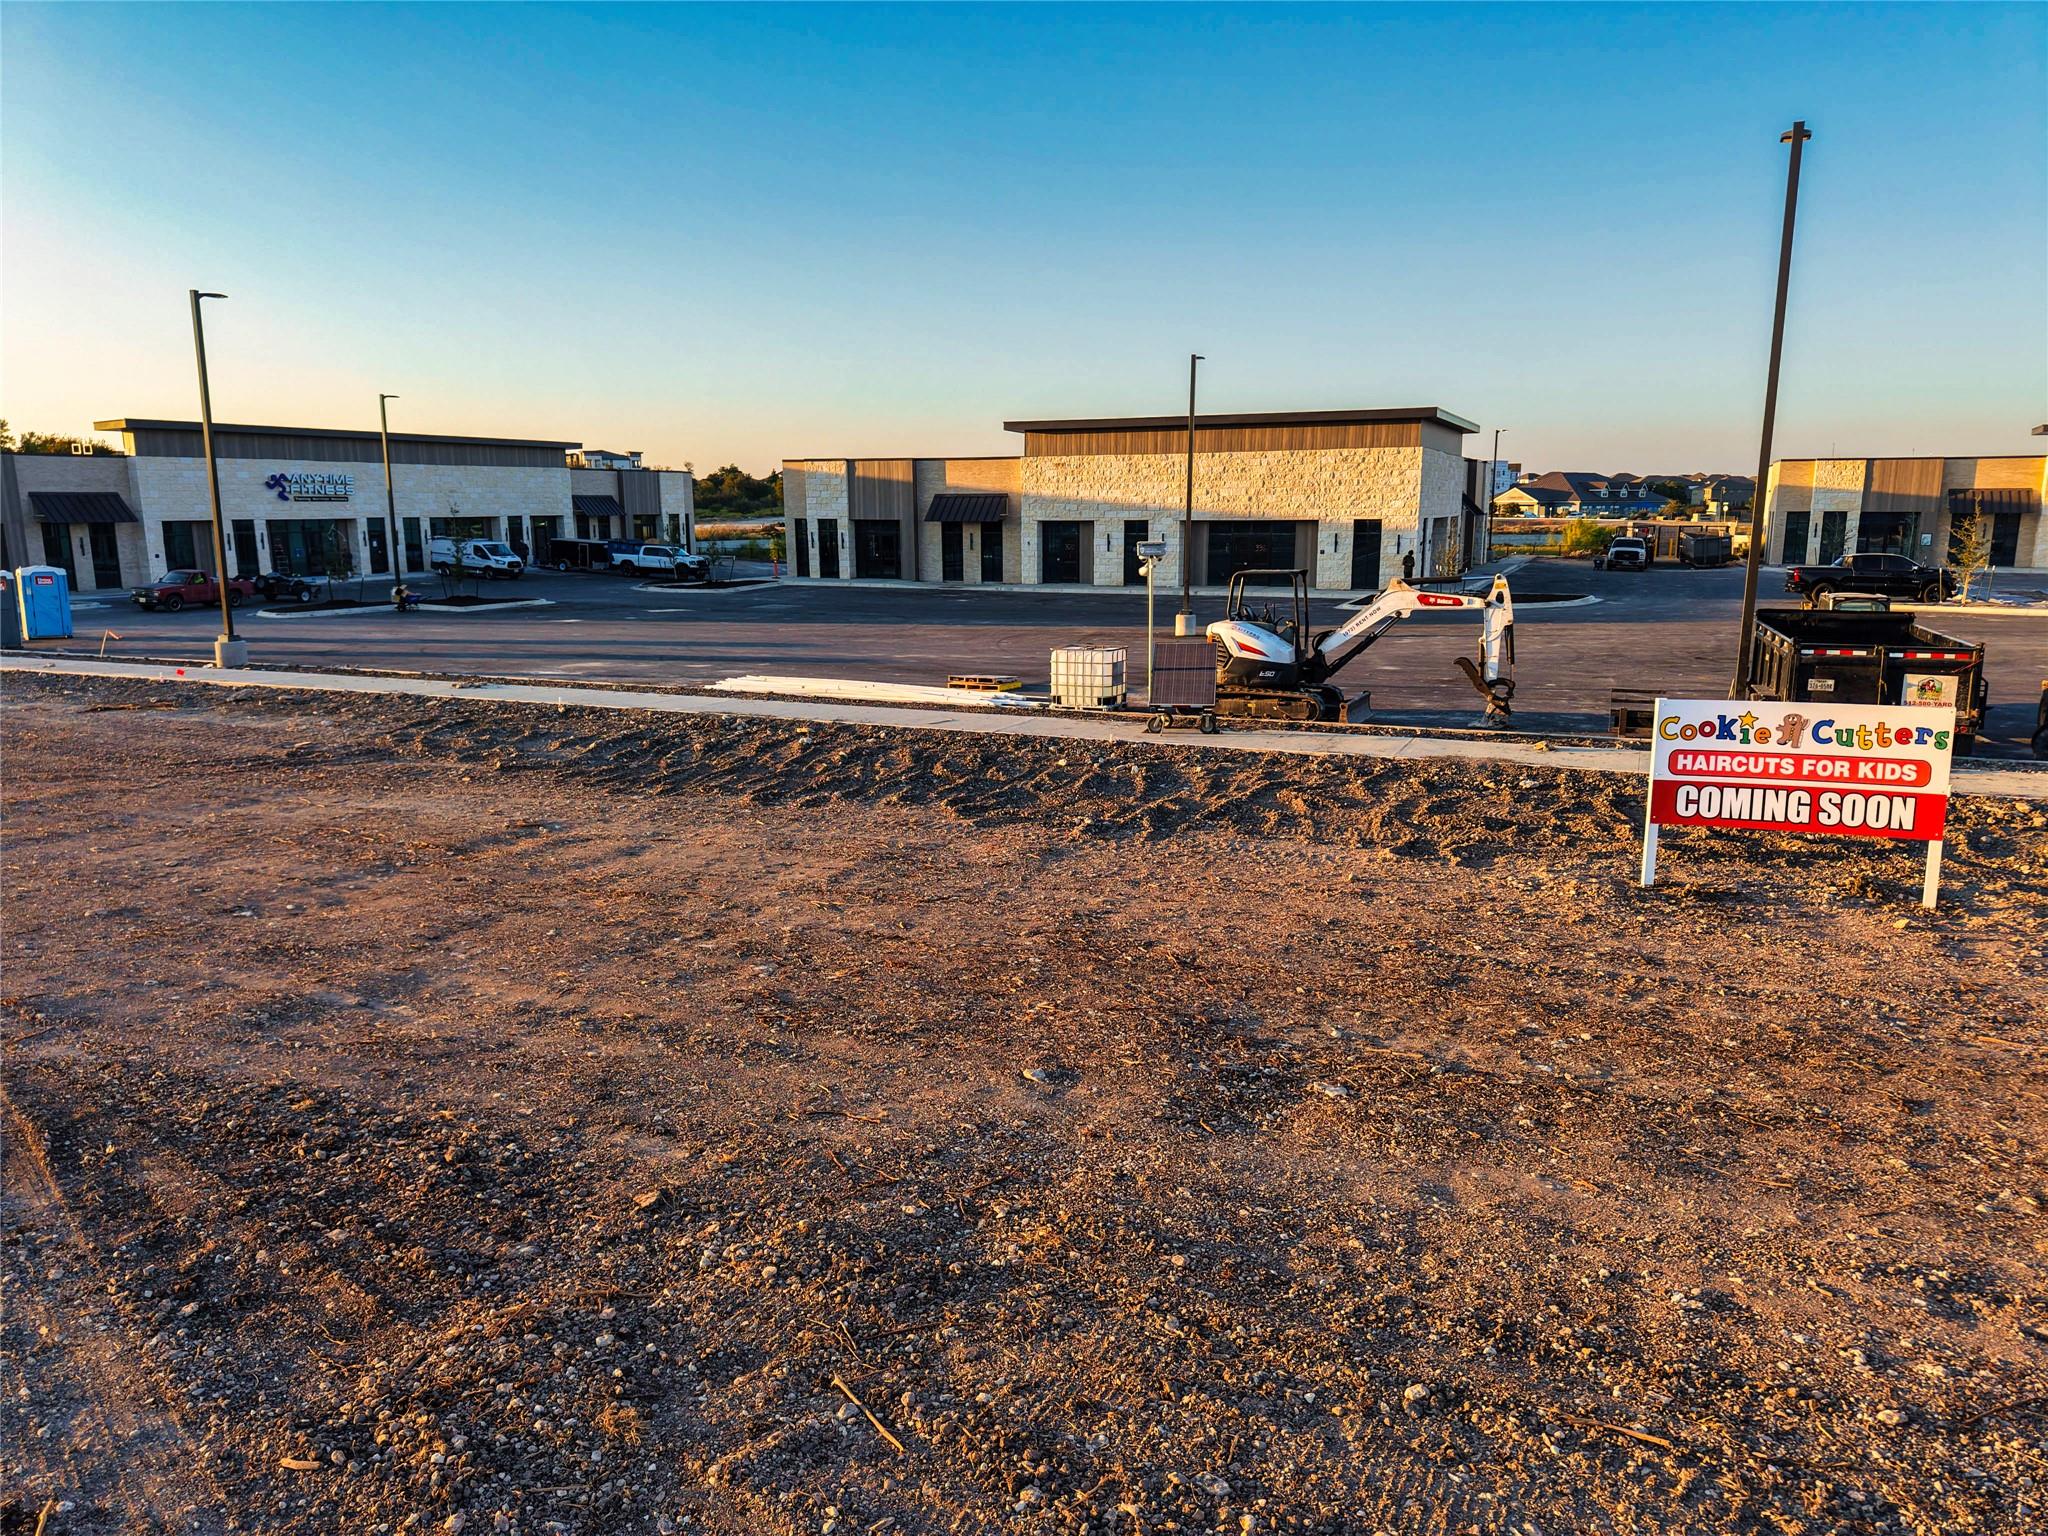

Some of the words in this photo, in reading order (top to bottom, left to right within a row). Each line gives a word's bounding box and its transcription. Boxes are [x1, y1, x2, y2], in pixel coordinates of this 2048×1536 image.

[291, 473, 354, 484] ANYTIME
[291, 484, 355, 495] FITNESS
[1355, 615, 1369, 627] RENT
[1369, 606, 1381, 617] NOW
[1659, 711, 1772, 745] Cookie
[1811, 719, 1950, 751] Cutters
[1677, 755, 1795, 776] HAIRCUTS
[1802, 760, 1850, 778] FOR
[1858, 762, 1918, 781] KIDS
[1676, 784, 1811, 824] COMING
[1818, 791, 1916, 831] SOON
